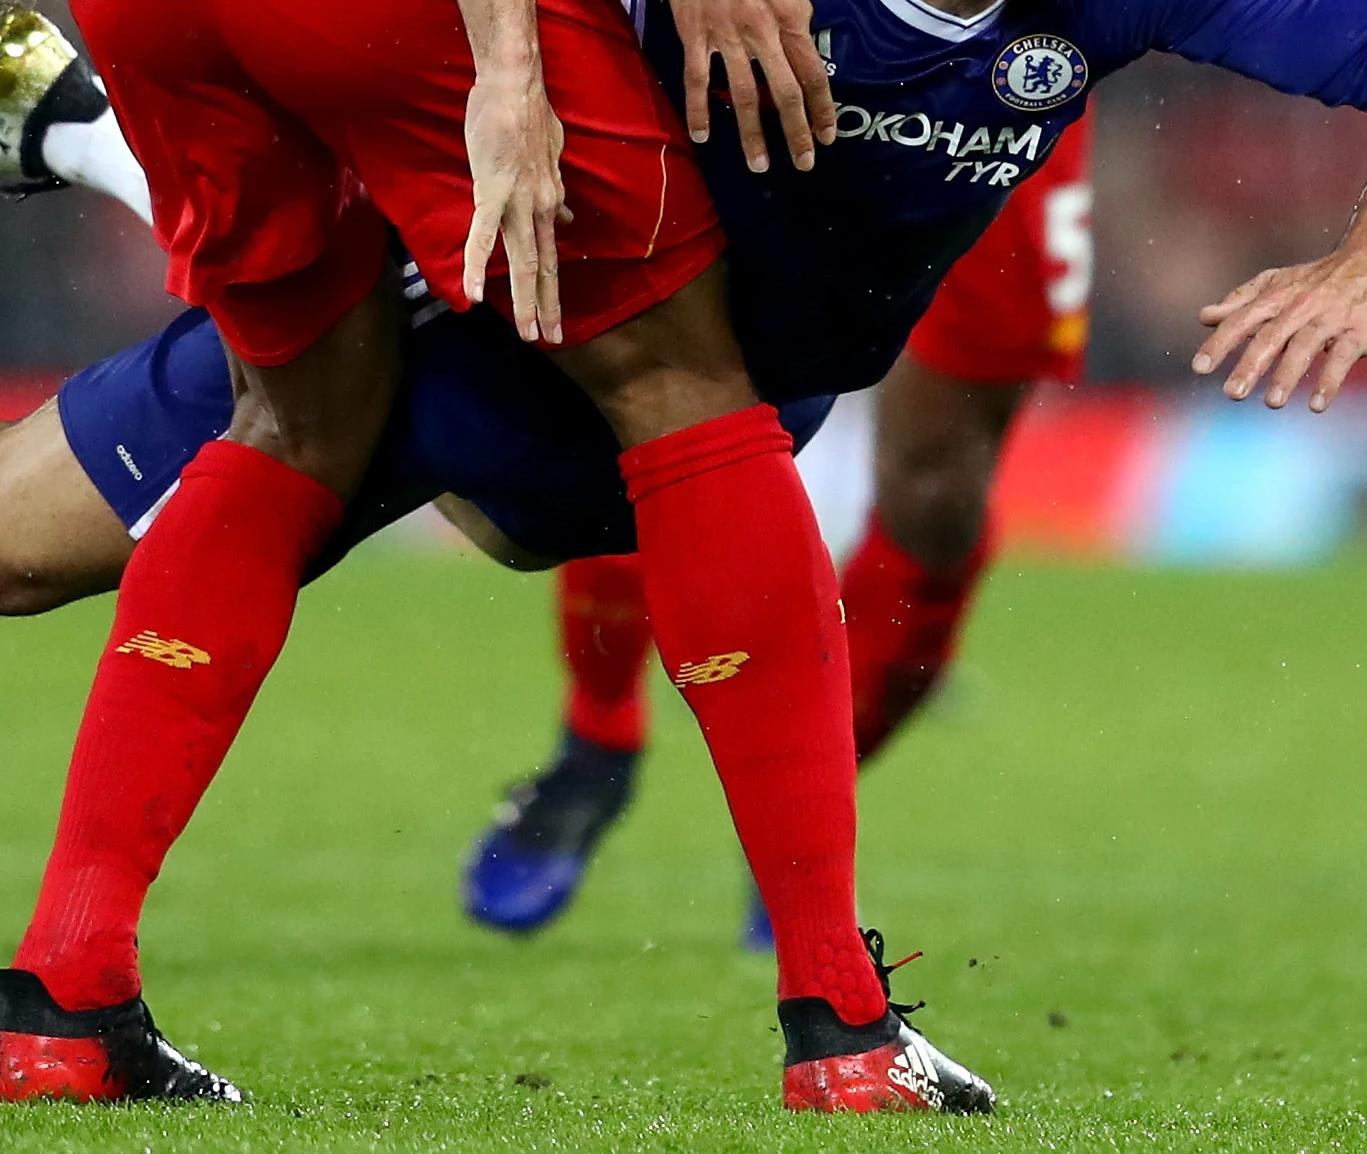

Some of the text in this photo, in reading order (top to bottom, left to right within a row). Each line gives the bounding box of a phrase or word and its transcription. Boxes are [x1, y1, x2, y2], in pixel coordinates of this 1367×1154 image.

[1013, 37, 1074, 59] CHELSEA
[1005, 93, 1068, 107] FOOTBALL CLUB
[834, 102, 1043, 162] OKOHAM
[1043, 183, 1095, 315] 5
[886, 1066, 945, 1112] adidas
